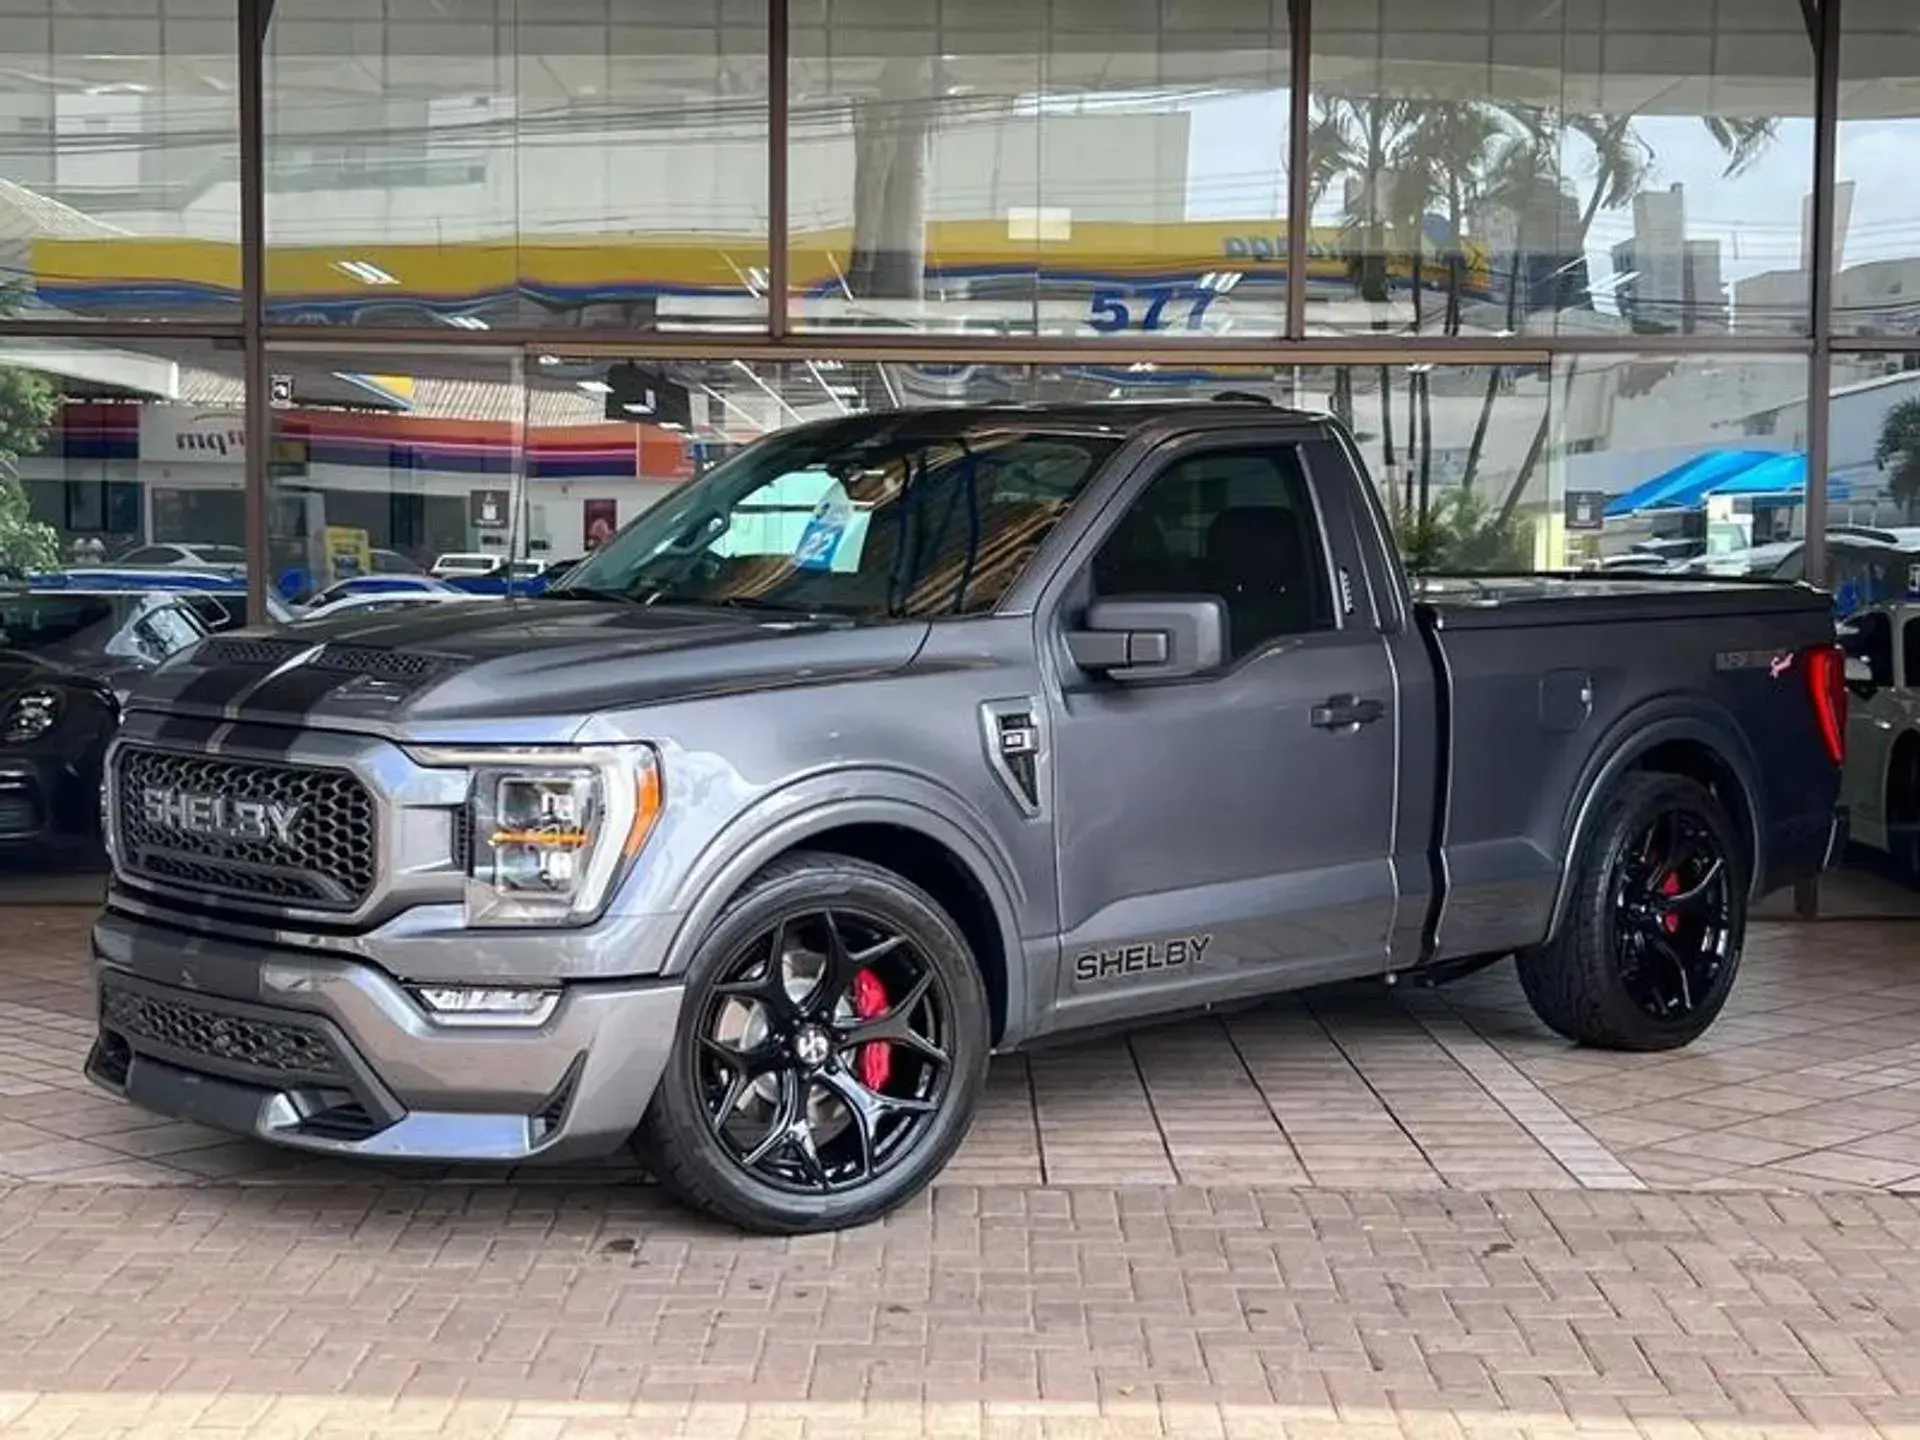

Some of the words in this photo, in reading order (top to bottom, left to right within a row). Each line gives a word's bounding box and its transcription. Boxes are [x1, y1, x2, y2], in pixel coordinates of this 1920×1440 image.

[1086, 285, 1216, 332] 577
[144, 787, 299, 844] SHELBY
[1075, 933, 1214, 984] SHELBY
